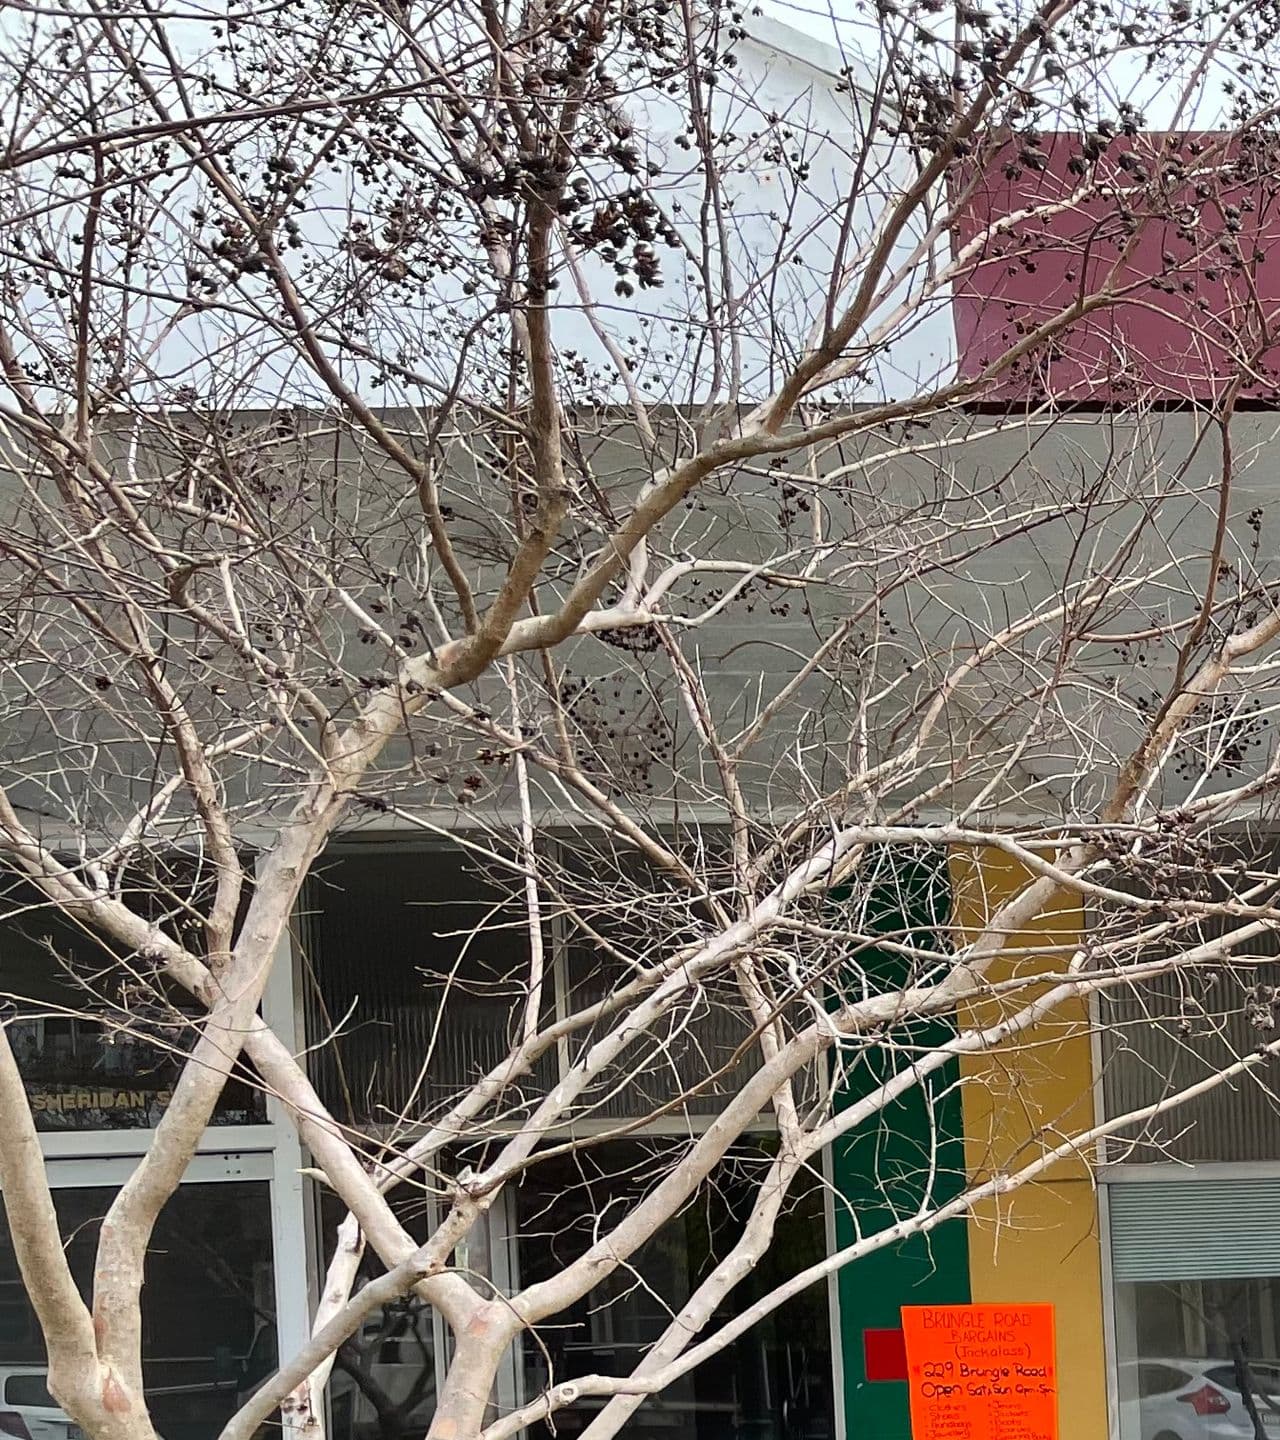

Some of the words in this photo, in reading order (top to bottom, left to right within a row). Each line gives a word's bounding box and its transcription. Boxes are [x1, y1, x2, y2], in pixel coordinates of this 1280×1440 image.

[30, 1090, 145, 1111] SHERIDAN
[994, 1312, 1032, 1327] ROAD
[951, 1329, 1016, 1343] BARGAINS
[922, 1361, 954, 1379] 229
[1013, 1362, 1047, 1378] Road
[921, 1382, 963, 1401] Open
